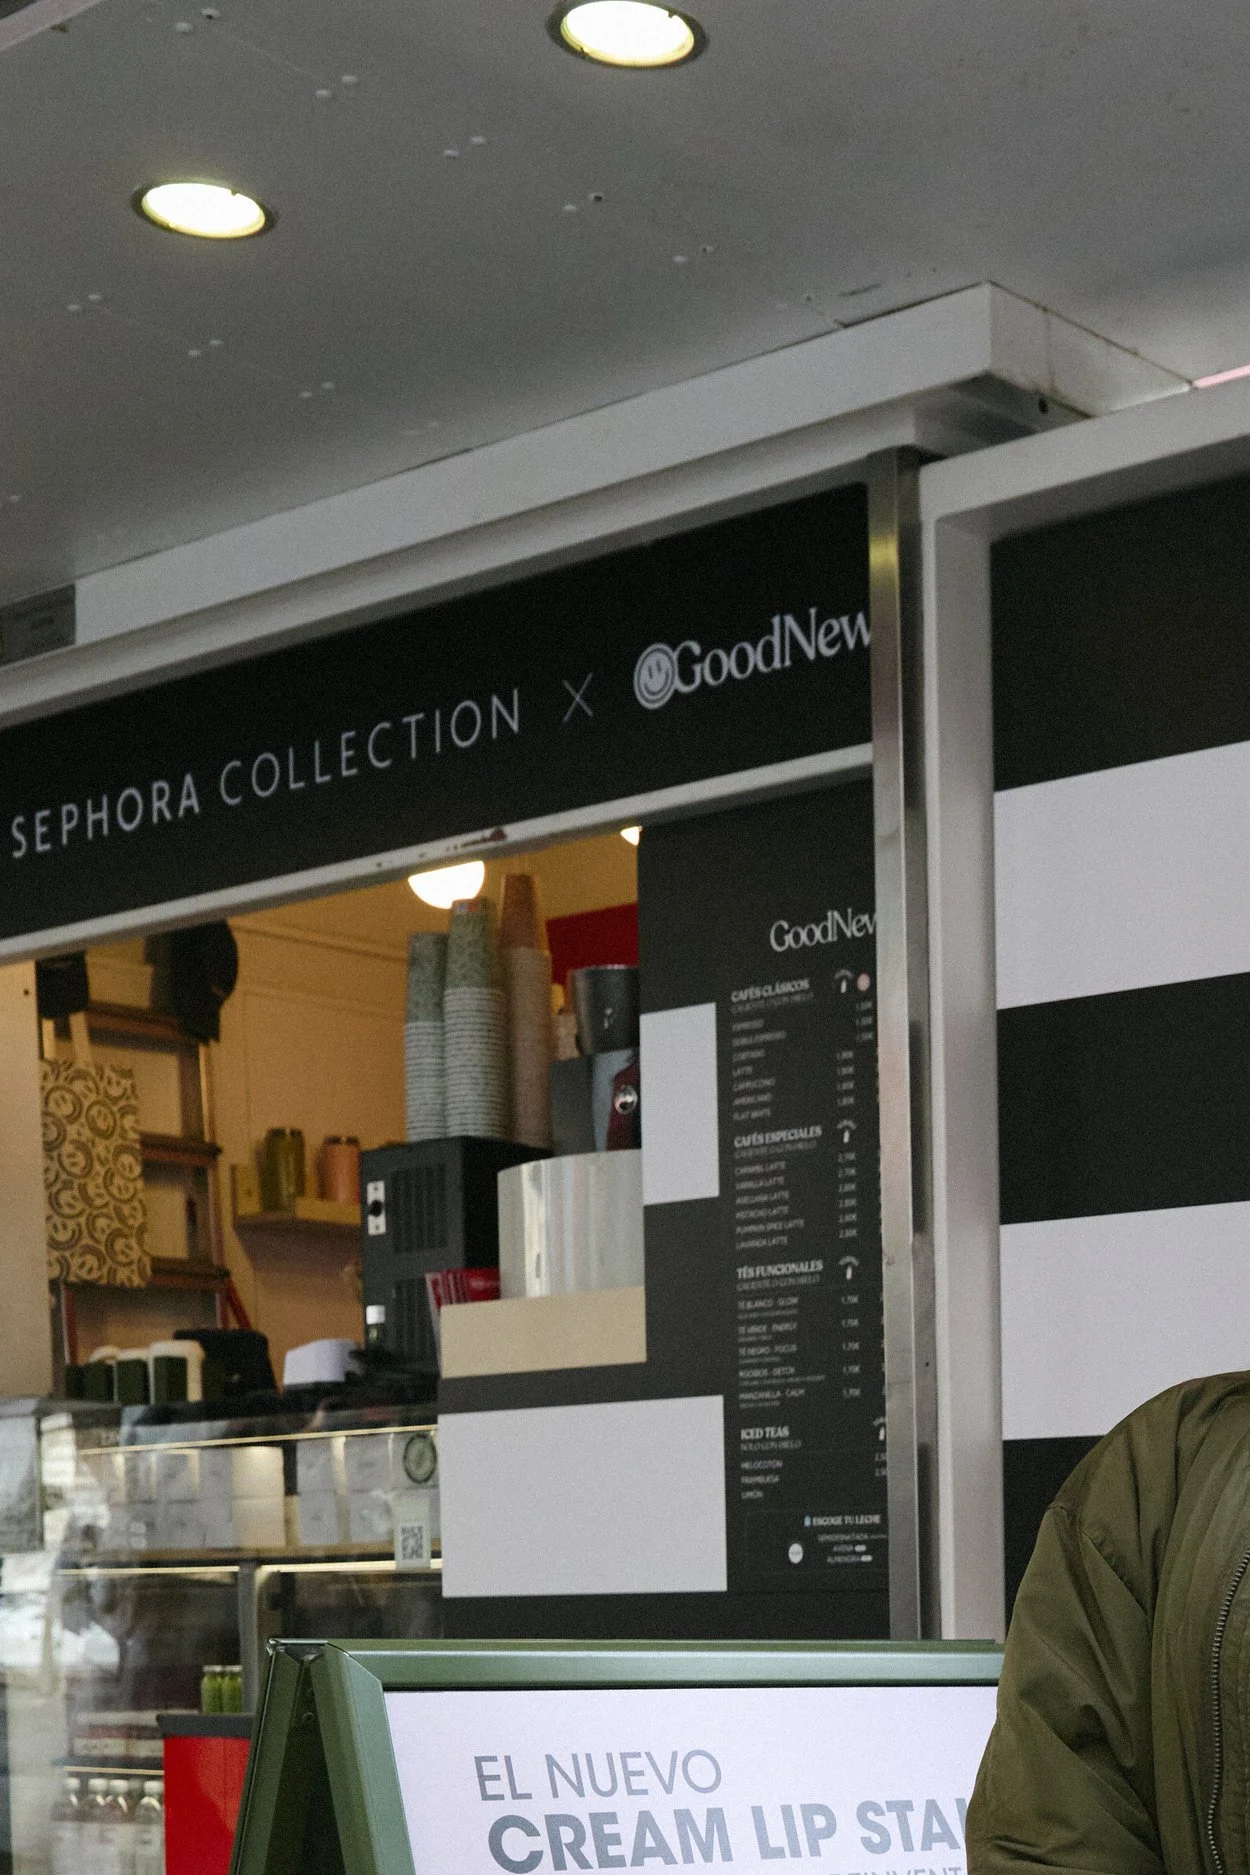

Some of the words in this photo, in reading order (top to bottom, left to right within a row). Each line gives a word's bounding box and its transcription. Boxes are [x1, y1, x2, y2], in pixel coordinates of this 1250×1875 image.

[11, 773, 201, 860] SEPHORA
[219, 688, 521, 807] COLLECTION
[472, 1755, 532, 1802] EL
[545, 1748, 722, 1798] NUEVO
[487, 1806, 734, 1875] CREAM
[750, 1802, 838, 1860] LIP
